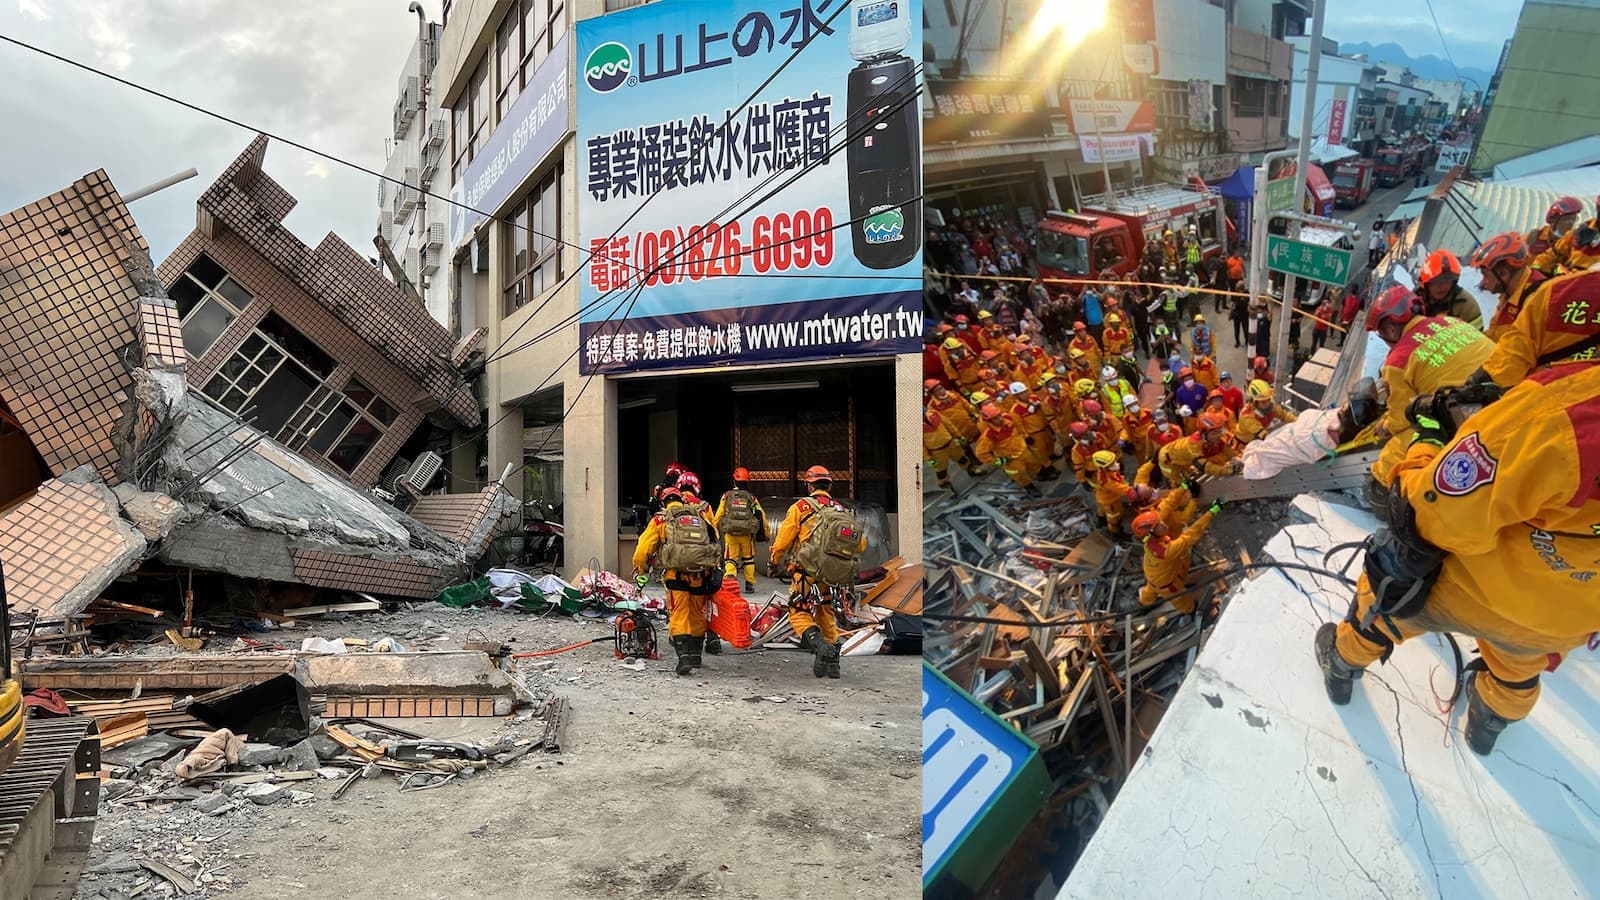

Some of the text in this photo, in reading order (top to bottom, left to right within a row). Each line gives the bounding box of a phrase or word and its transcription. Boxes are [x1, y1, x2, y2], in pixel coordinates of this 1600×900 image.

[639, 0, 836, 83] 山上の水
[587, 92, 831, 202] 專業桶裝飲水供應商
[1279, 242, 1338, 269] 民族街
[745, 305, 924, 350] www.mtwater.tw
